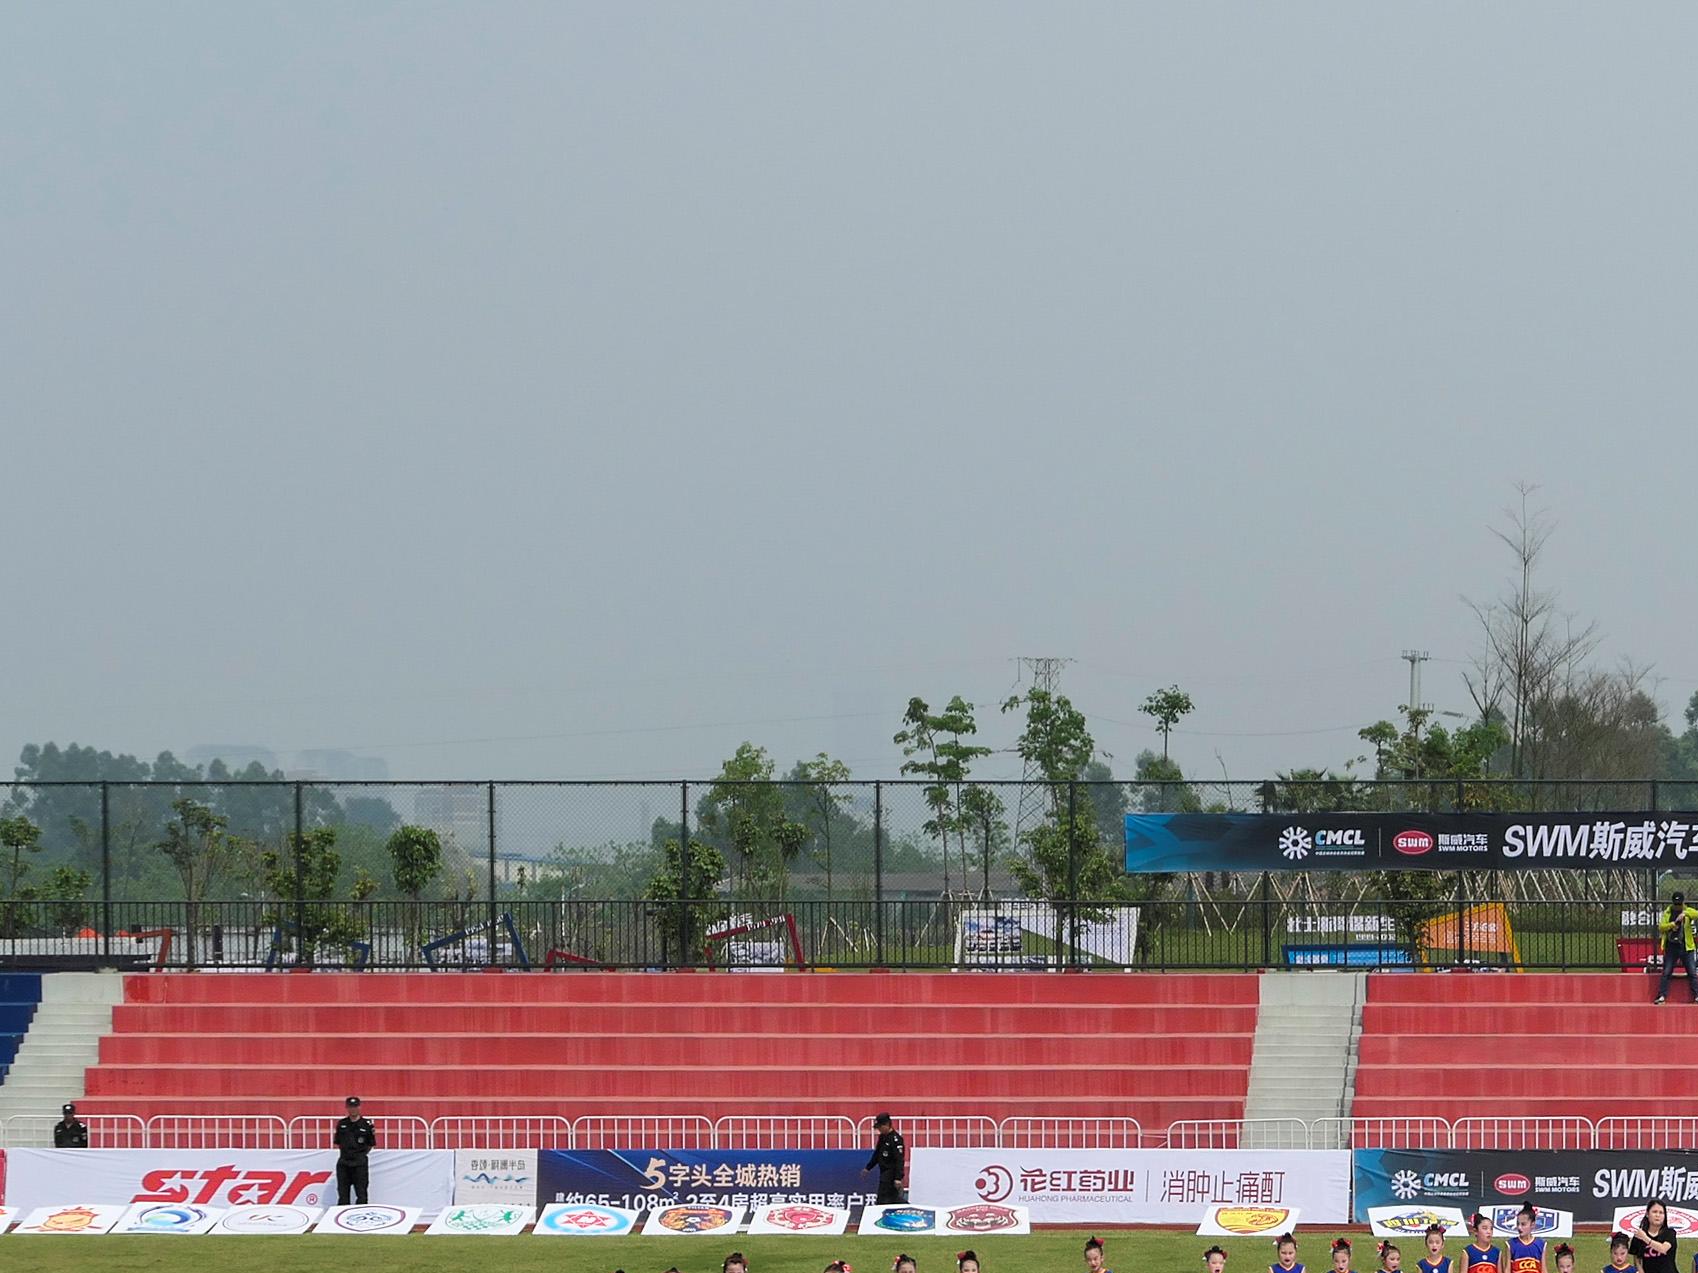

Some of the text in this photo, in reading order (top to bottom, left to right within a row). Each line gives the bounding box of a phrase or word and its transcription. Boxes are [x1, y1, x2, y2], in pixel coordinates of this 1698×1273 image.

[1315, 830, 1365, 845] CMCL
[1397, 838, 1430, 848] SWM
[1438, 834, 1488, 846] 斯威汽车
[640, 1157, 800, 1190] 5字头全城热销
[131, 1165, 332, 1206] star
[1020, 1167, 1285, 1205] 花红药业 消肿止痛酊
[1423, 1173, 1469, 1187] CMCL
[1498, 1180, 1528, 1189] SWM
[1535, 1176, 1580, 1187] 斯威汽车
[1018, 1195, 1133, 1203] HUAHONG PHARMACEUTICAL
[1519, 1260, 1536, 1269] CCA
